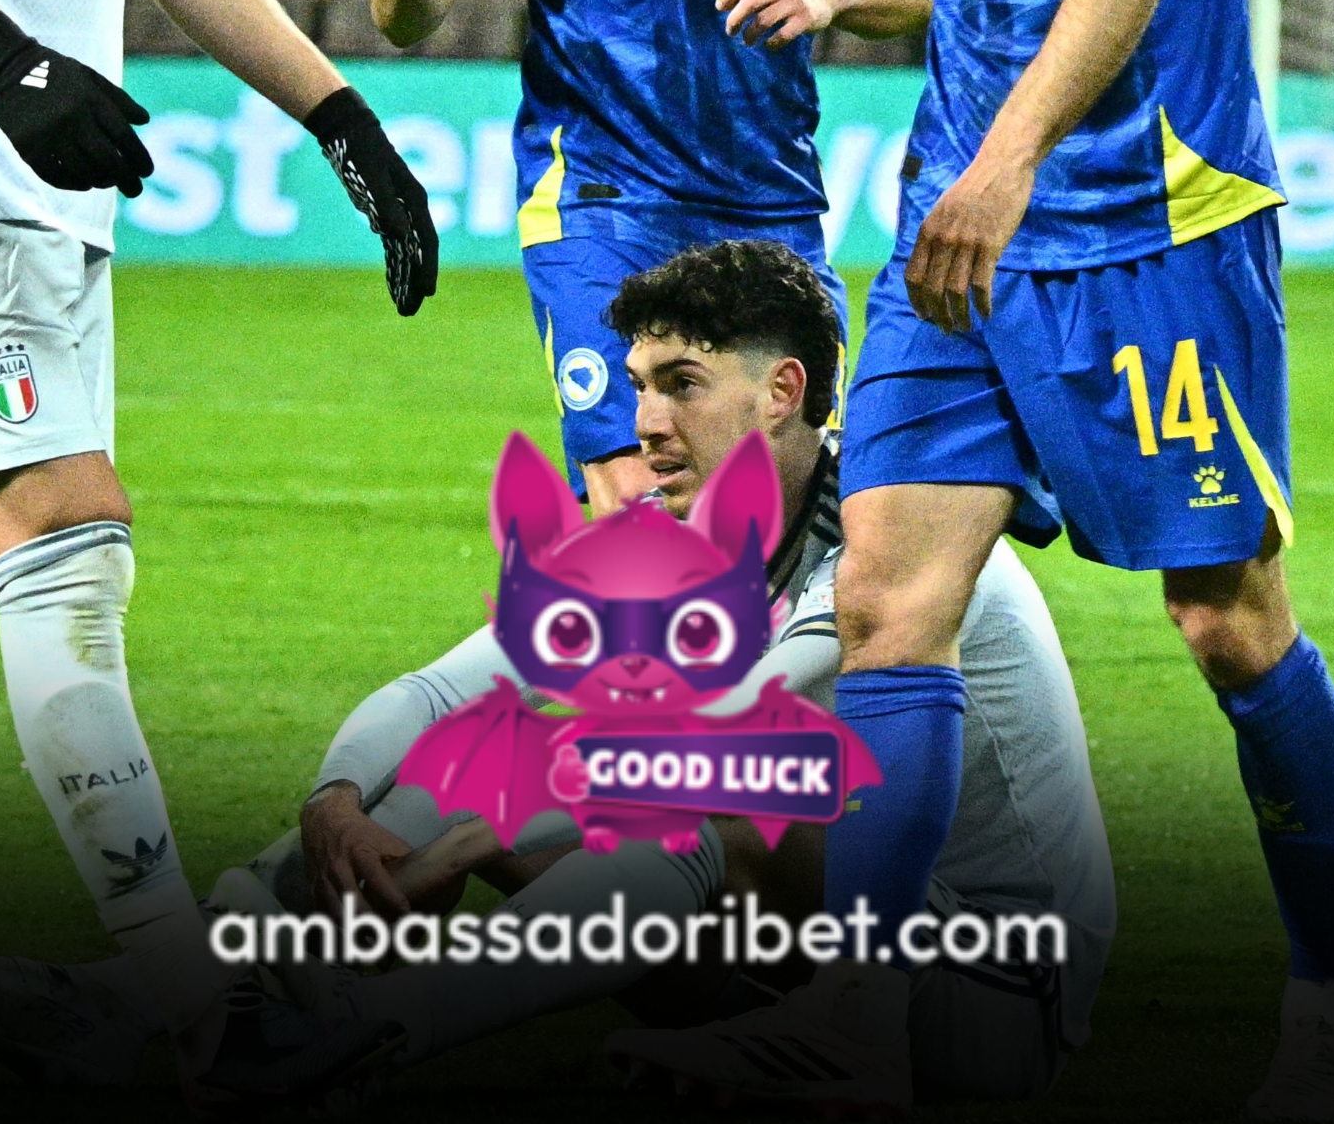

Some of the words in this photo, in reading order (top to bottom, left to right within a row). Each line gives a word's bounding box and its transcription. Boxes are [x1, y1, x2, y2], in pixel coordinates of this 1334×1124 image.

[1112, 338, 1219, 456] 14
[1187, 493, 1240, 508] KELME
[58, 758, 149, 794] ITALIA
